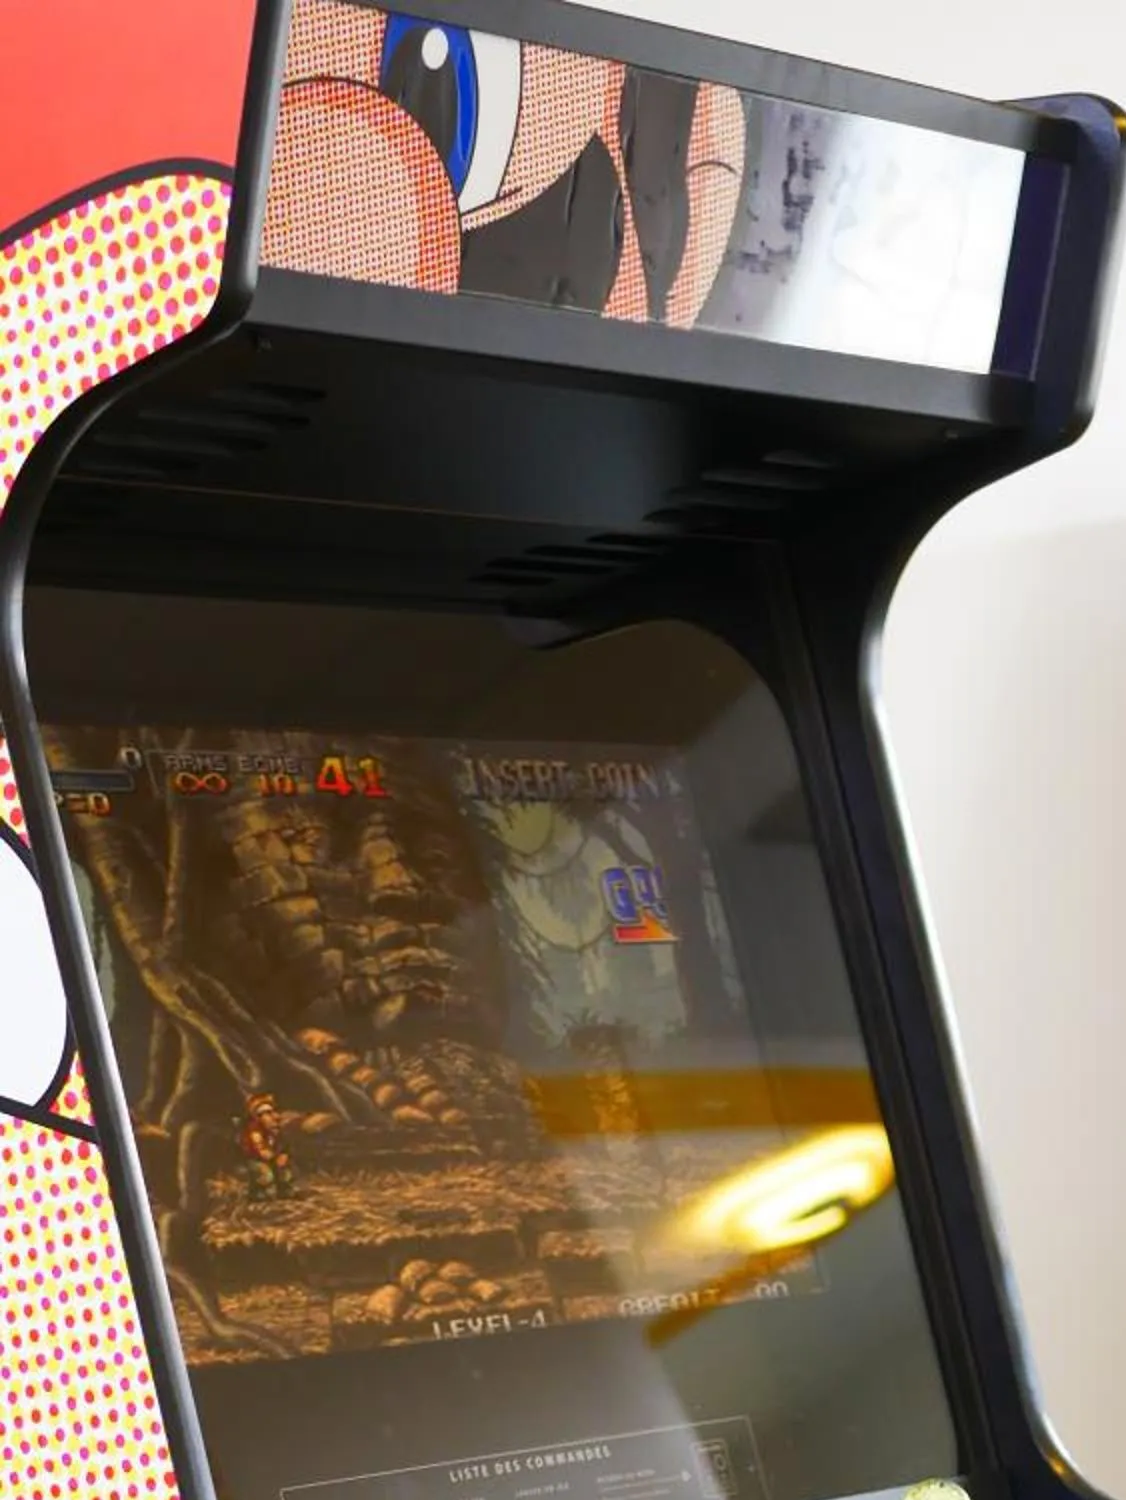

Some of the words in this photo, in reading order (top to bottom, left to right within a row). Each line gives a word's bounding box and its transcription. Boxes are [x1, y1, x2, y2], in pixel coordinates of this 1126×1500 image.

[314, 755, 386, 797] 41
[461, 758, 568, 798] INSERT
[431, 1308, 547, 1341] LEVEL-4
[449, 1463, 490, 1484] LISTE
[495, 1458, 522, 1476] DES
[526, 1444, 612, 1470] COMMANDES
